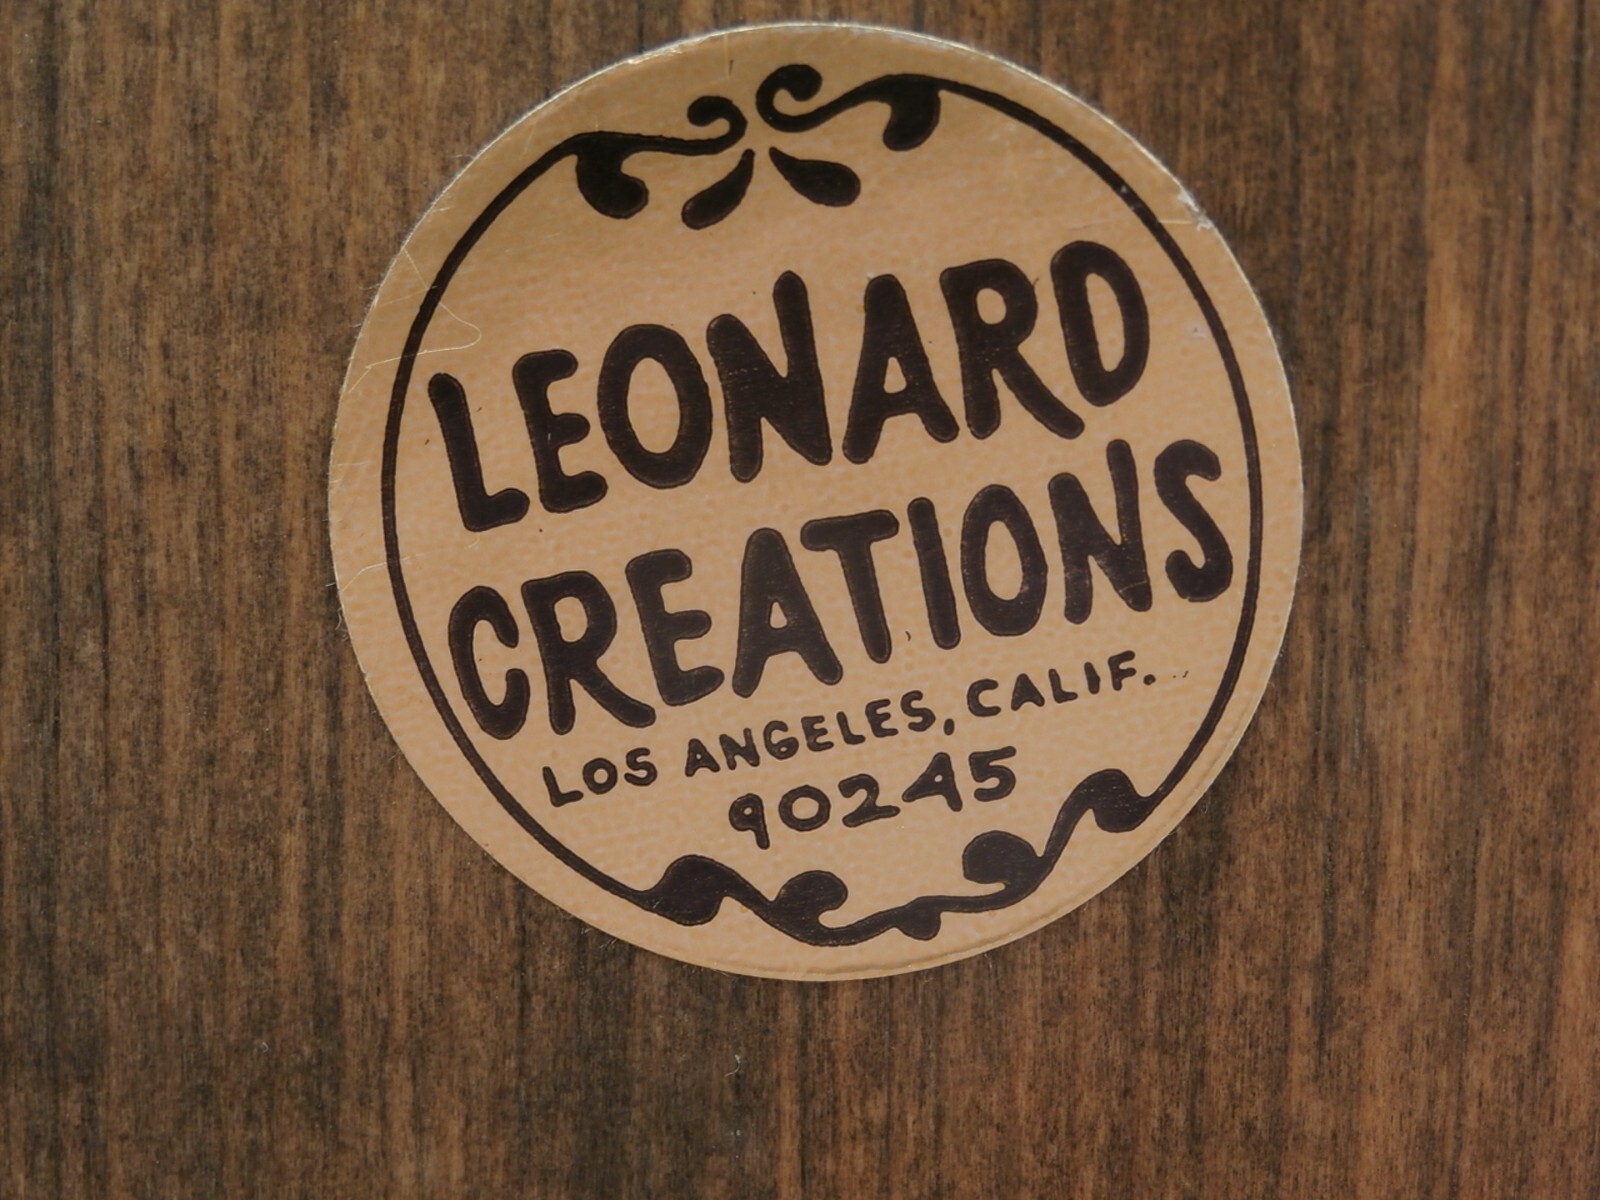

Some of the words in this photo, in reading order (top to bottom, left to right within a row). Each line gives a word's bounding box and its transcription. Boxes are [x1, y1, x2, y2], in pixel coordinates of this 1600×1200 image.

[428, 241, 1149, 533] LEONARD
[448, 439, 1233, 741] CREATIONS
[542, 747, 658, 808] LOS
[684, 690, 956, 777] ANGELES,
[966, 650, 1156, 718] CALIF.
[729, 745, 1017, 850] 90245
